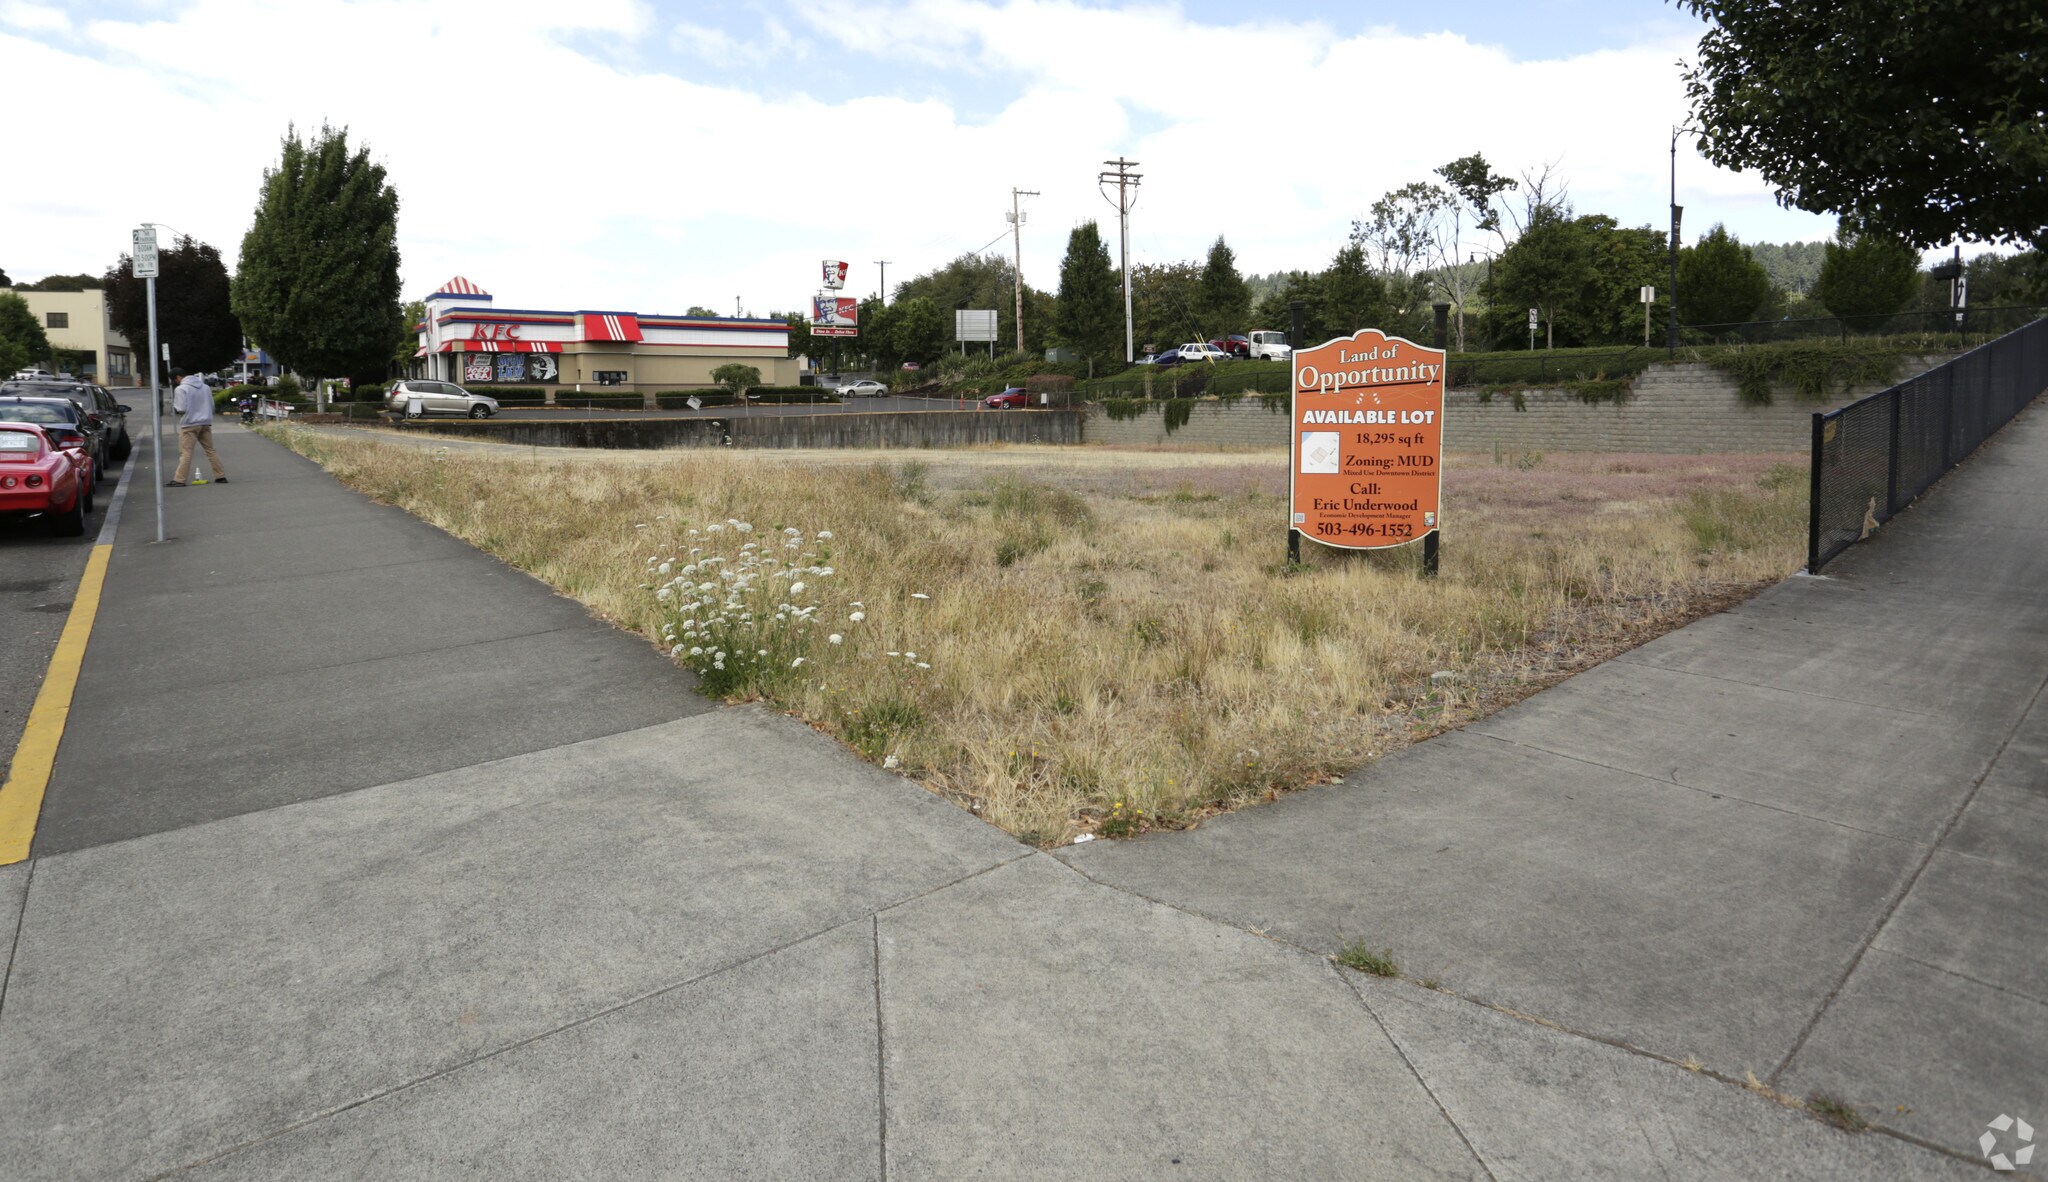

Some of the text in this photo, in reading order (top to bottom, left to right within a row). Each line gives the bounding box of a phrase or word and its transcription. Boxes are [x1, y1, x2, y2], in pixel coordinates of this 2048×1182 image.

[134, 230, 138, 241] 2
[839, 304, 854, 314] KFC
[471, 322, 520, 340] KFC
[1340, 344, 1400, 364] Land of
[1298, 360, 1440, 394] Opportunity
[1302, 410, 1434, 424] AVAILABLE LOT
[1356, 433, 1424, 447] 18,295 sq ft
[1345, 455, 1434, 469] Zoning: MUD
[1350, 483, 1381, 494] Call:
[1314, 498, 1418, 511] Eric Underwood
[1317, 522, 1412, 537] 503-496-1552
